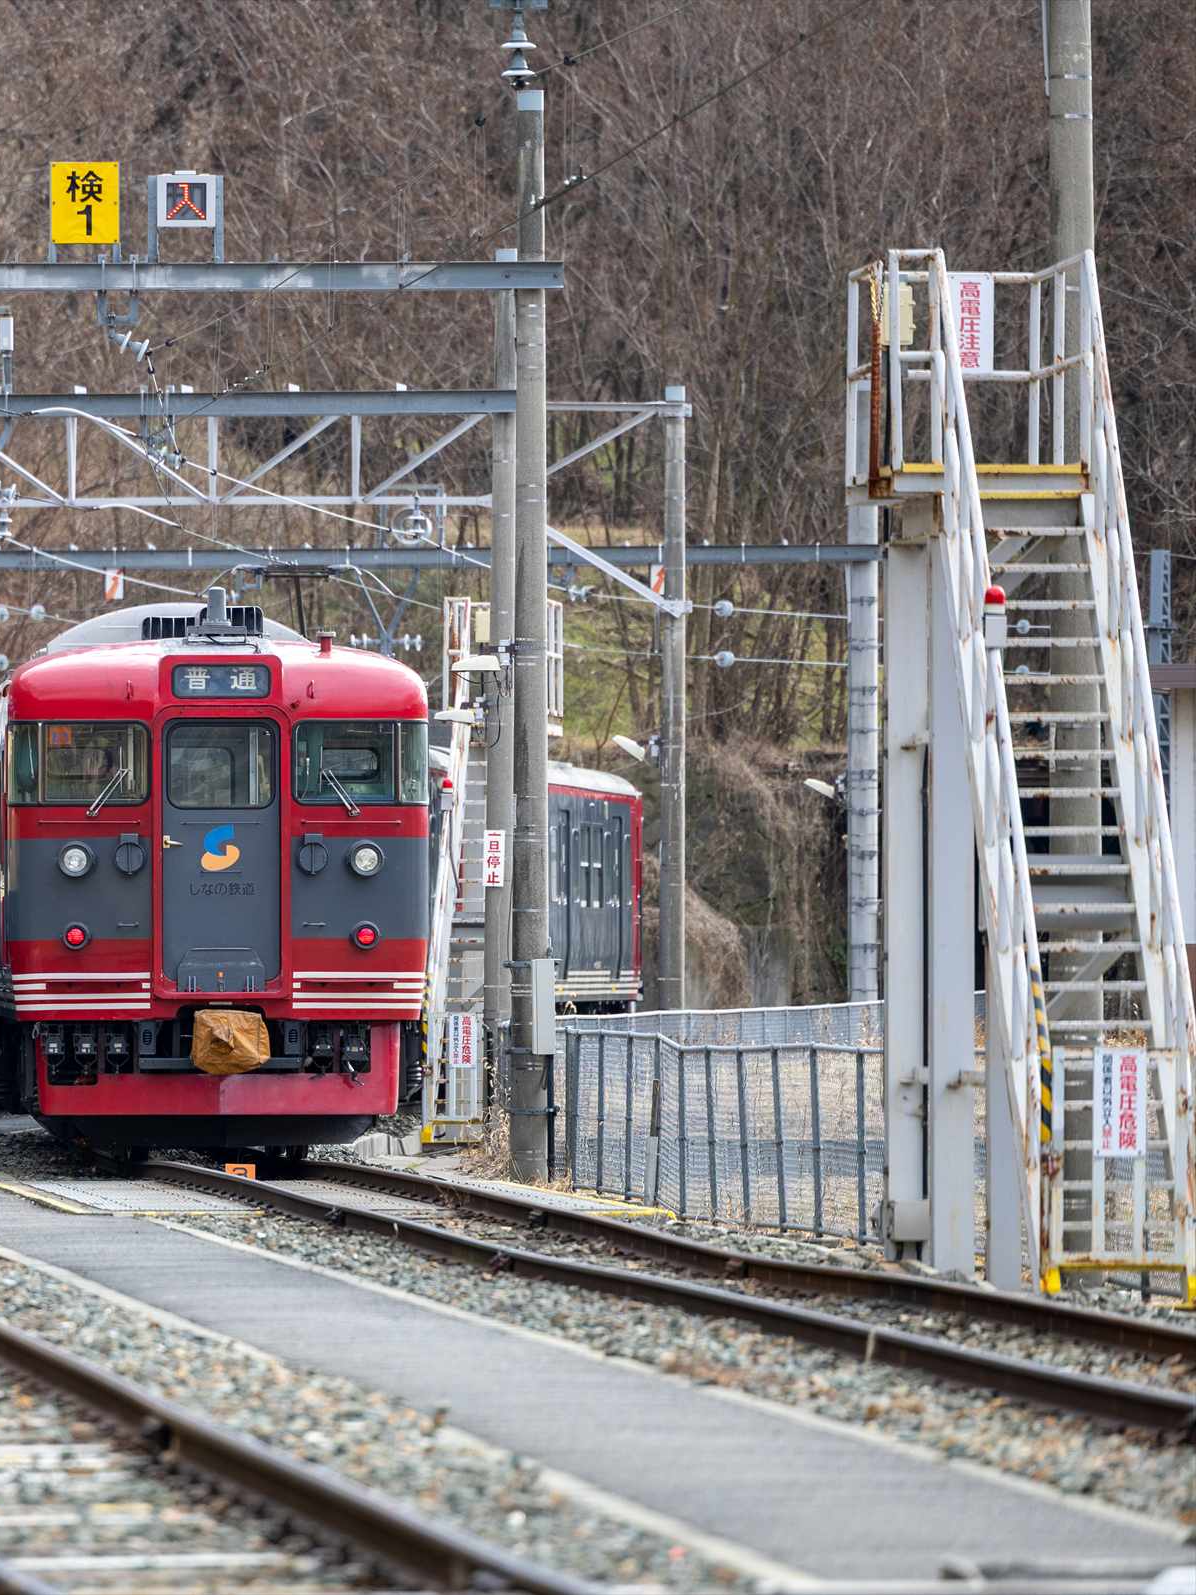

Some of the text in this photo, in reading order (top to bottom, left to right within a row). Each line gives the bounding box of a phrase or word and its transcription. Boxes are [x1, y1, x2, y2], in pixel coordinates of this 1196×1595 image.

[959, 281, 981, 368] 高電圧注意
[184, 667, 257, 690] 普通
[486, 832, 501, 884] 一旦停止
[189, 881, 255, 896] しなの鉄道
[1119, 1055, 1138, 1149] 高電圧危険
